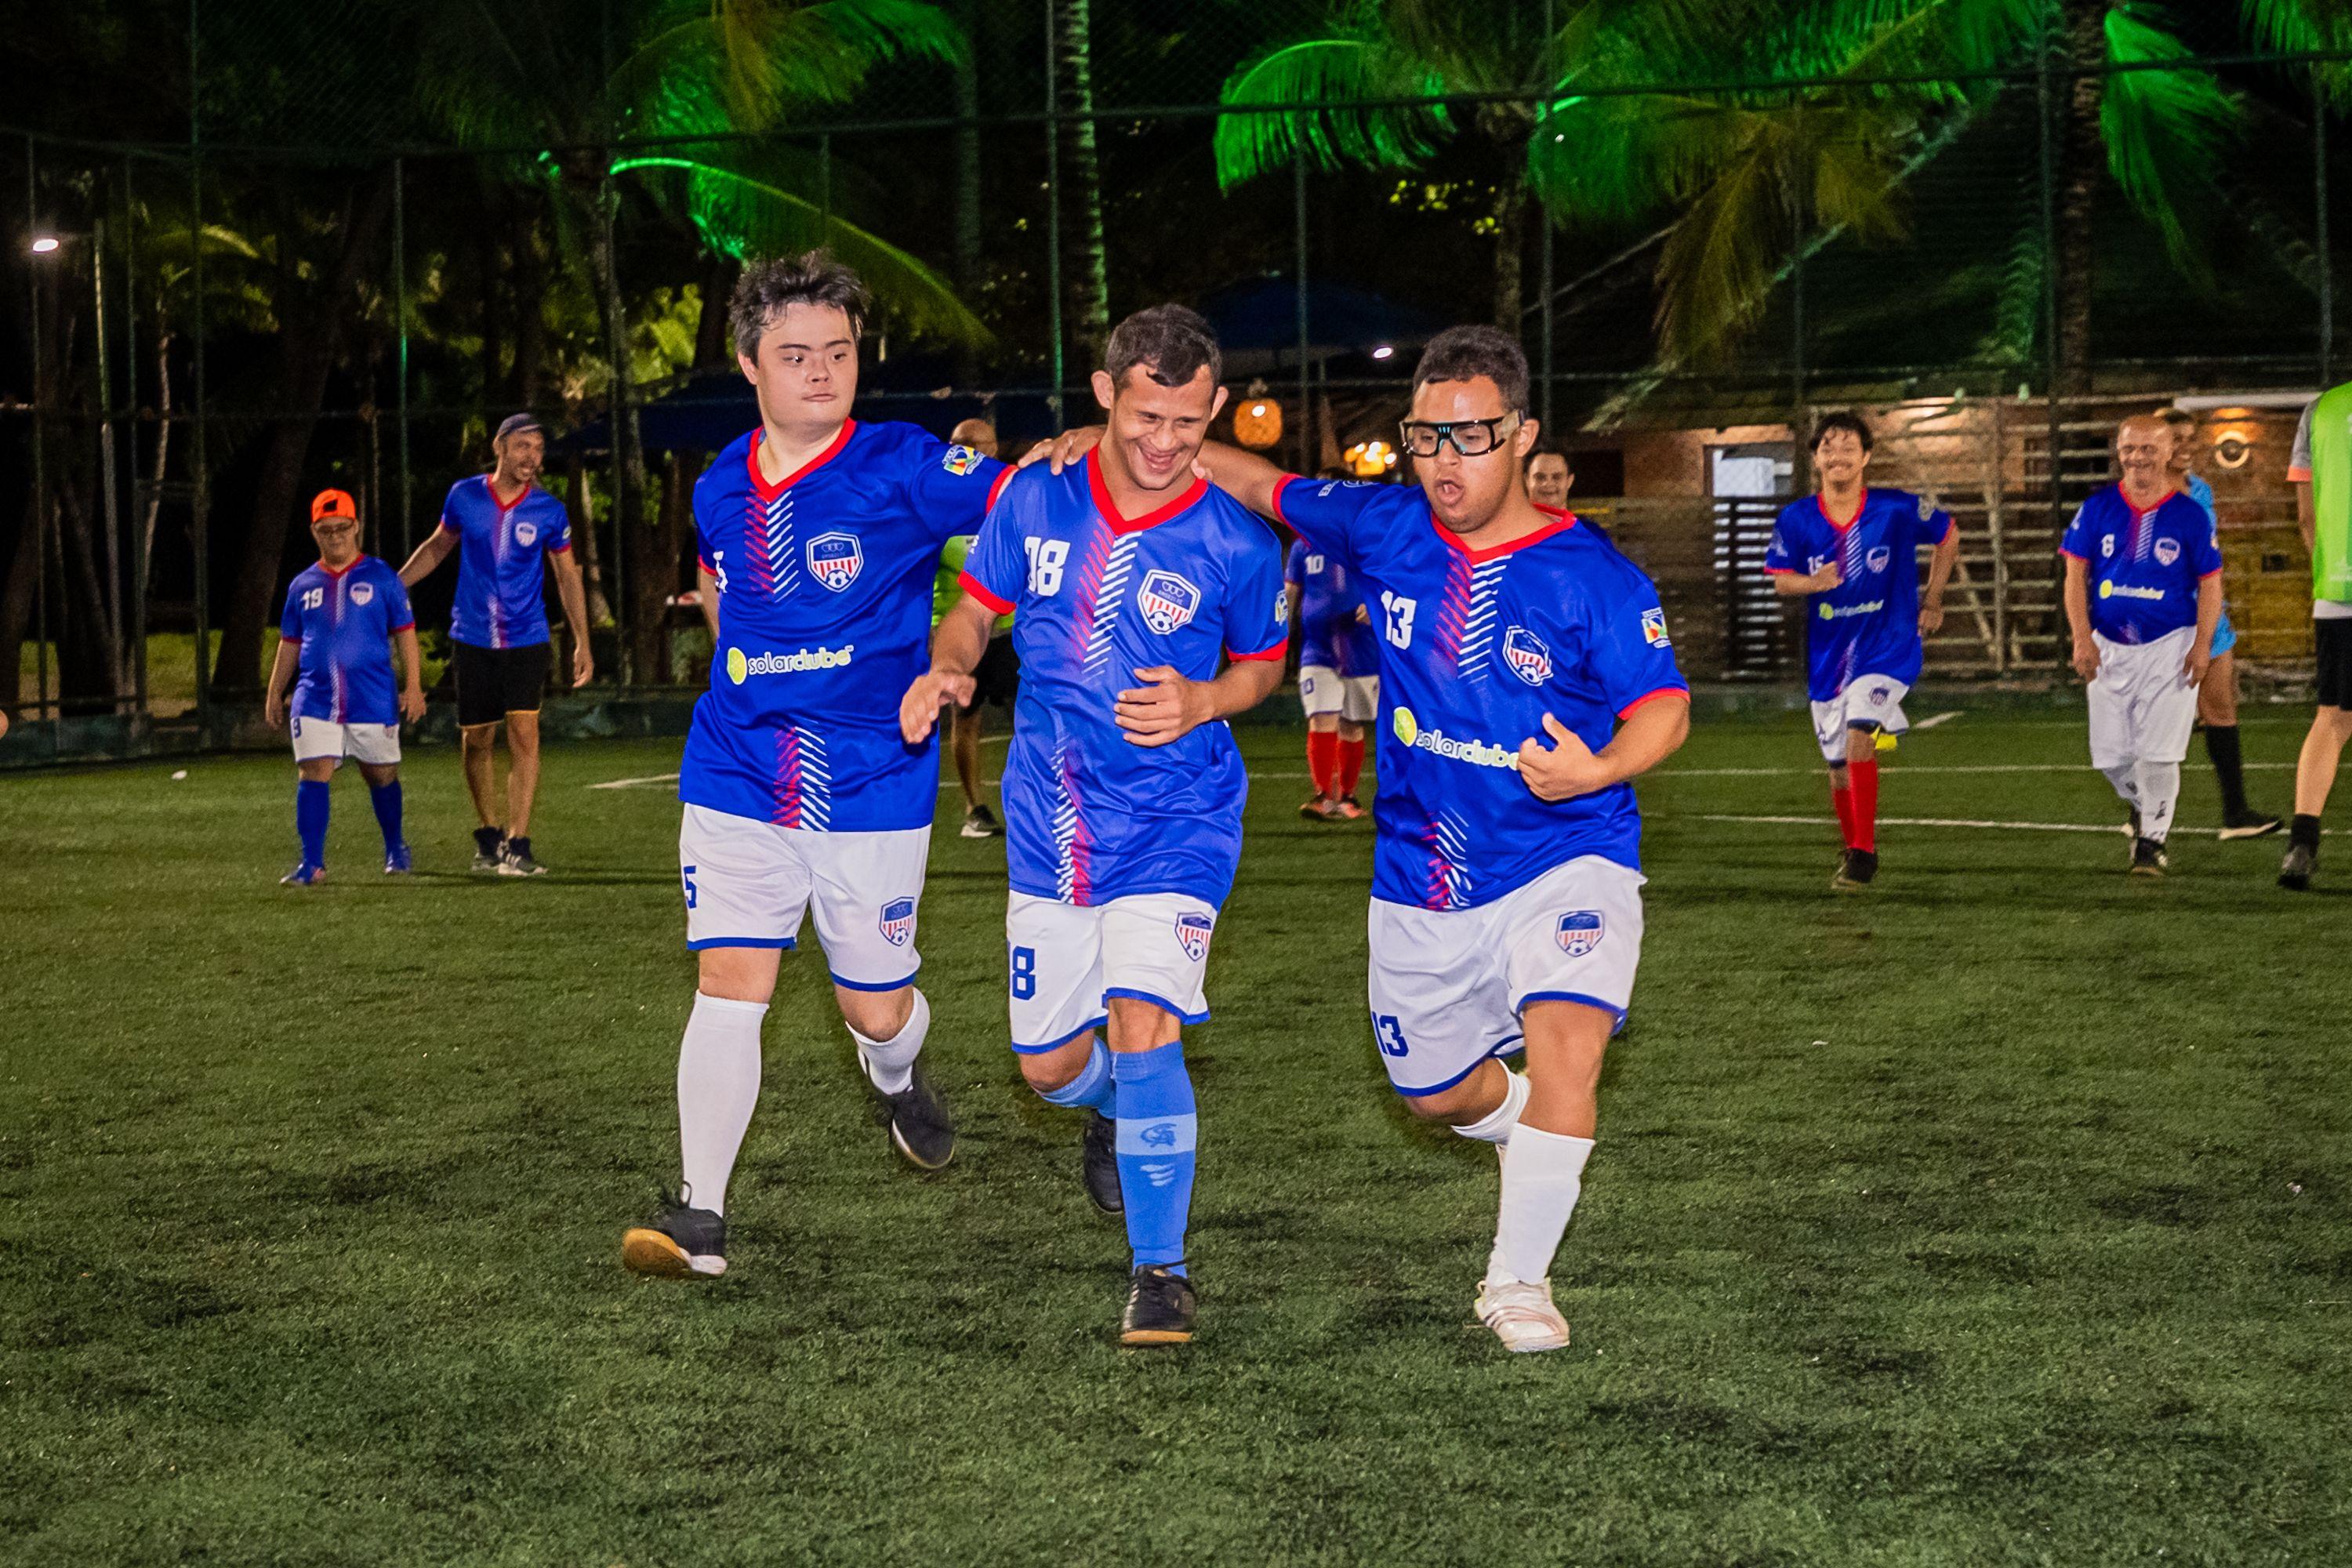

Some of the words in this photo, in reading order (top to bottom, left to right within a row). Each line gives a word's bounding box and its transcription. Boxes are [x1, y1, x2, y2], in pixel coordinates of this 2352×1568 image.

[1025, 536, 1070, 596] 18
[1305, 555, 1323, 575] 10
[302, 588, 323, 611] 19
[1381, 590, 1417, 650] 13
[748, 646, 852, 675] solarclube
[684, 866, 697, 909] 5
[1008, 944, 1036, 1000] 8
